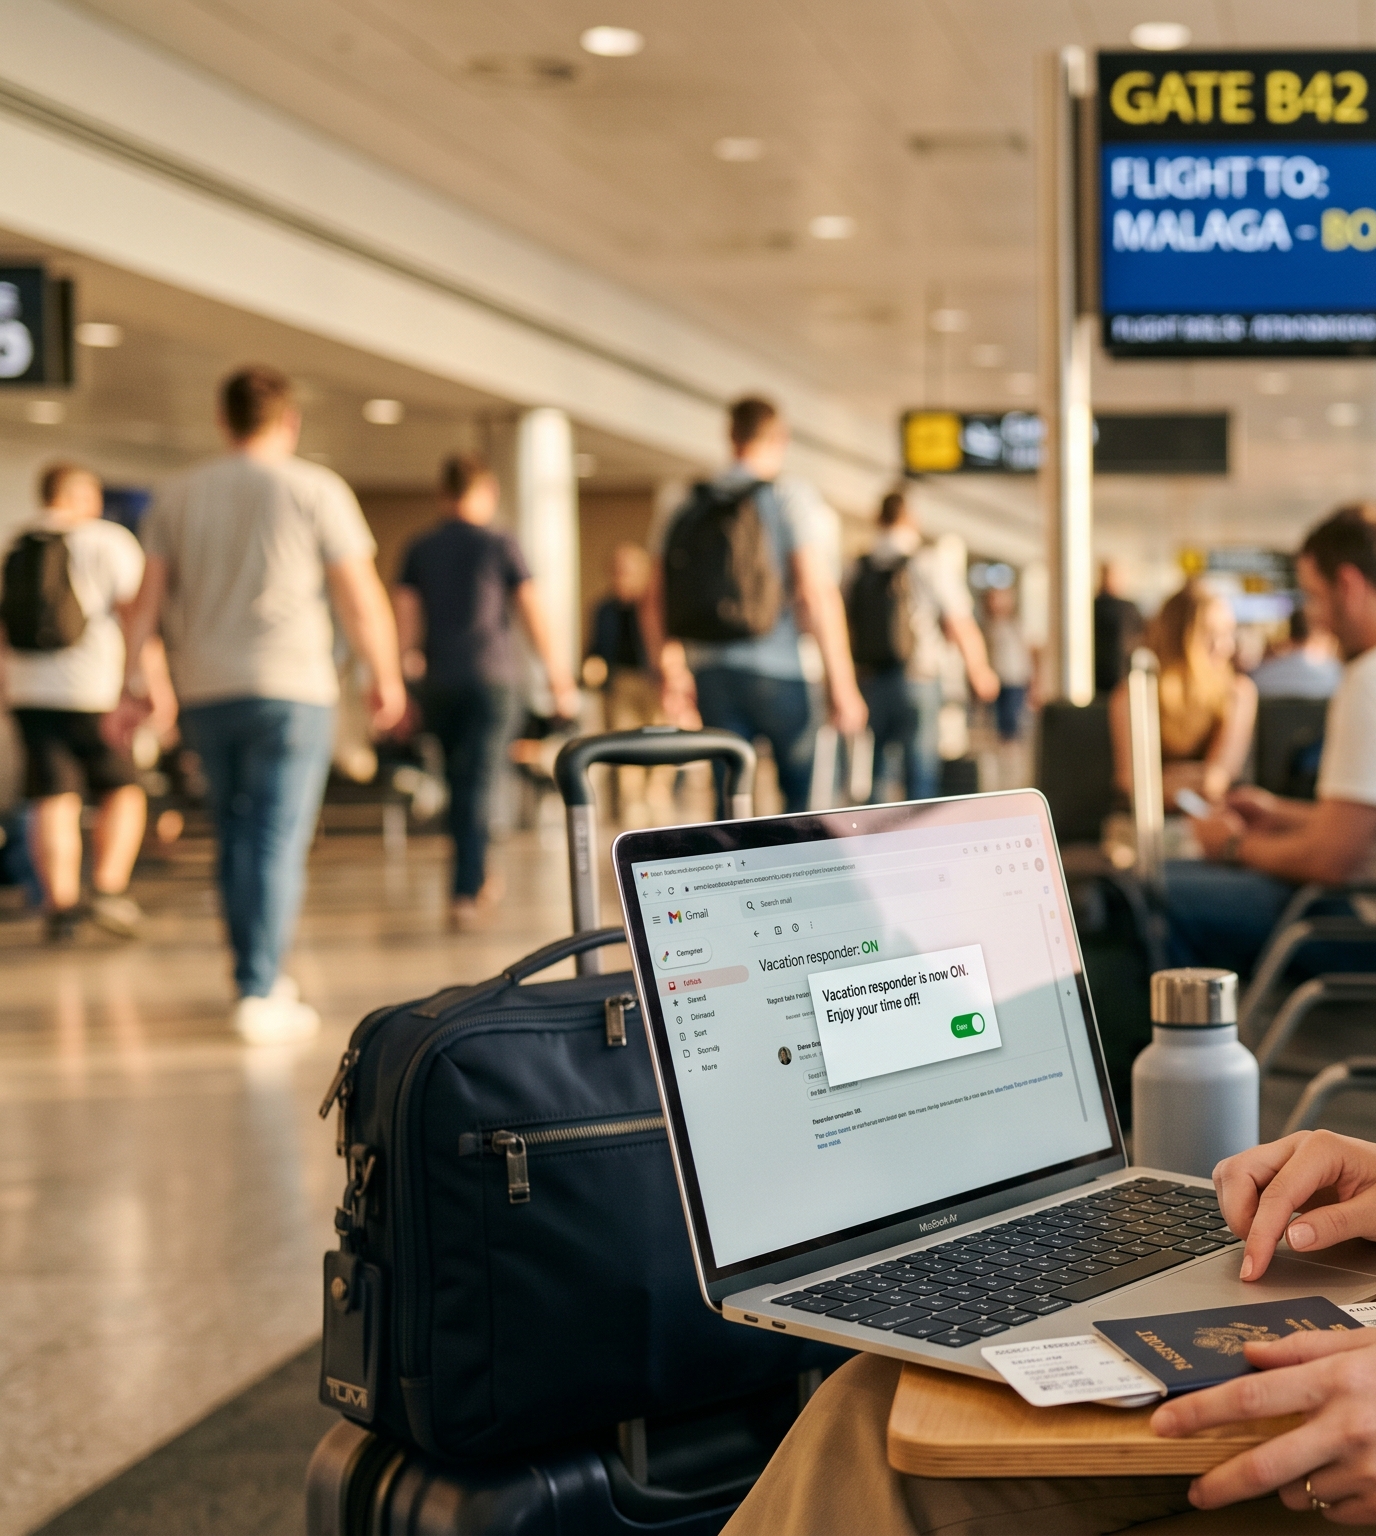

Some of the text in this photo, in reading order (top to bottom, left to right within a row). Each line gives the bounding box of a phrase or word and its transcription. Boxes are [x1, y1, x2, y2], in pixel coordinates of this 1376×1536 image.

[1110, 70, 1368, 125] GATE B42
[1111, 155, 1330, 200] FLIGHT TO:
[1112, 209, 1293, 252] MALAGA
[685, 908, 709, 920] Gmail
[759, 940, 879, 971] Vacation responder: ON
[822, 984, 867, 1002] Vacation
[868, 974, 917, 994] responder
[918, 972, 927, 984] is
[928, 970, 949, 982] now
[949, 964, 969, 978] ON.
[826, 1008, 855, 1024] Enjoy
[856, 1003, 878, 1020] your
[879, 999, 902, 1012] time
[904, 992, 921, 1007] off!
[326, 1376, 368, 1409] TUMI
